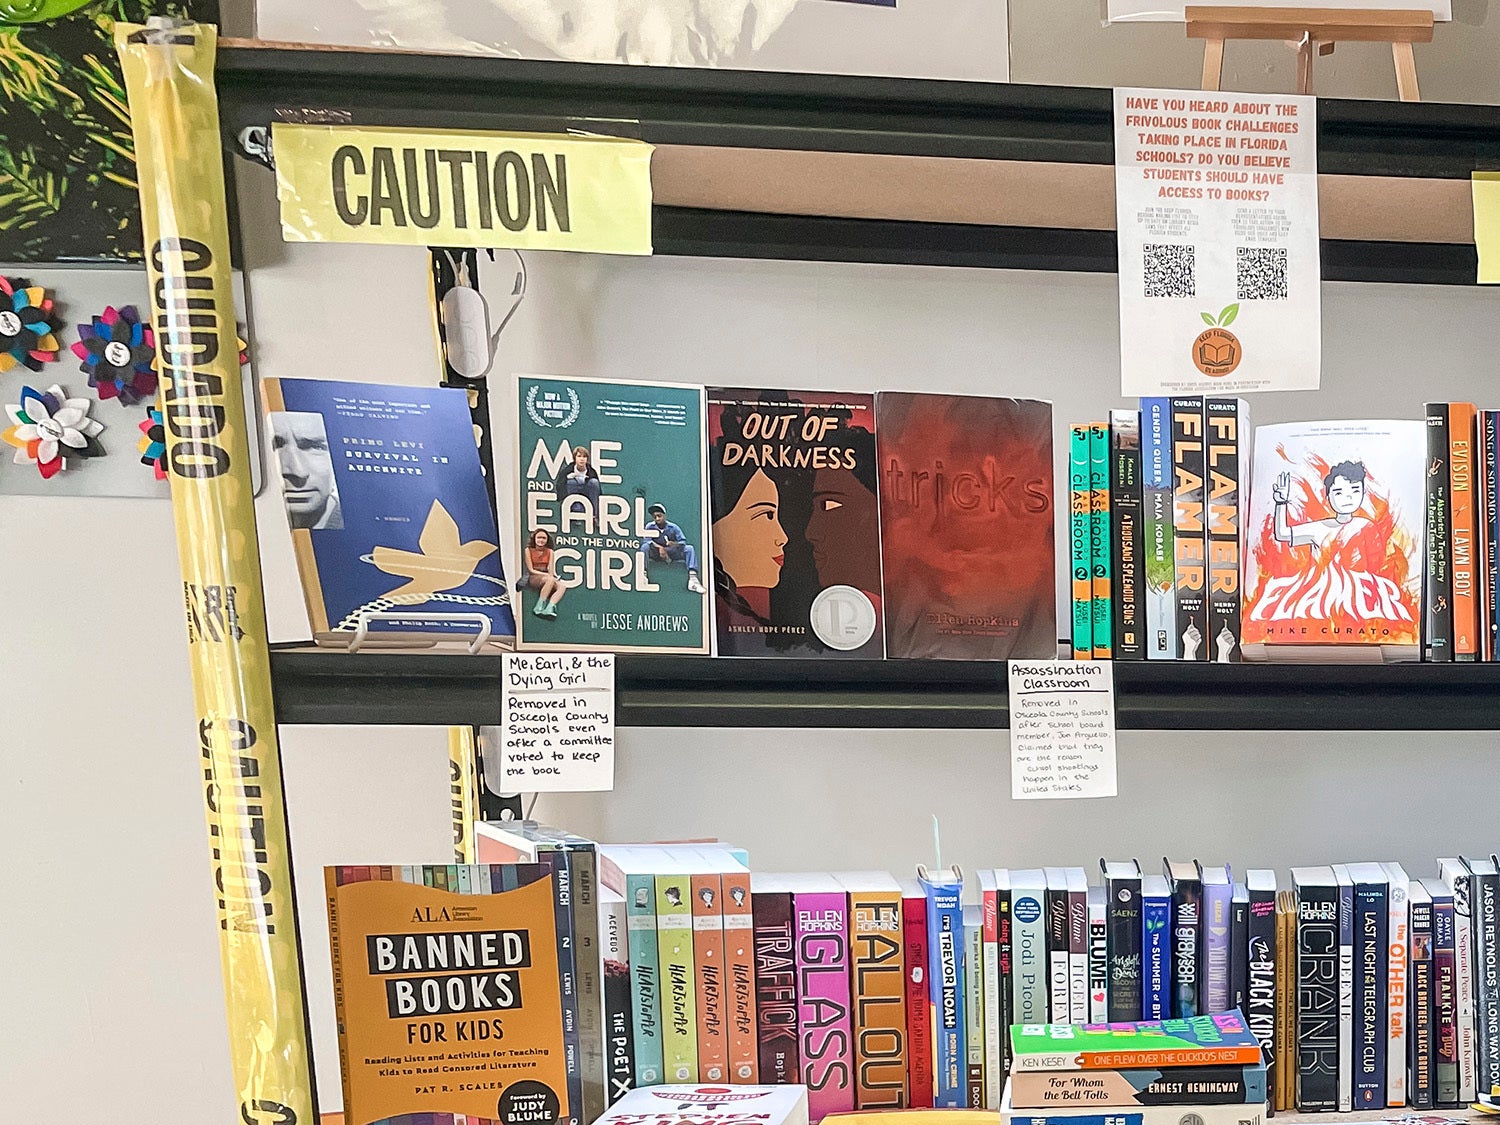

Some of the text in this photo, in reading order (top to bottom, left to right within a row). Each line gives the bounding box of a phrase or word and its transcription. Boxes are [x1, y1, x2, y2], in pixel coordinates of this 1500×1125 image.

[1126, 97, 1298, 116] HAVE YOU HEARD ABOUT THE
[1126, 116, 1298, 133] FRIVOLOUS BOOK CHALLENGES
[1138, 133, 1287, 150] TAKING PLACE IN FLORIDA
[1136, 151, 1290, 168] SCHOOLS? DO YOU BELIEVE
[1143, 169, 1284, 184] STUDENTS SHOULD HAVE
[331, 144, 571, 233] CAUTION
[1158, 187, 1269, 201] ACCESS TO BOOKS?
[152, 238, 231, 480] CUIDADO
[742, 413, 839, 441] OUT OF
[723, 443, 857, 470] DARKNESS
[1174, 411, 1204, 593] FLAMER
[528, 493, 659, 537] EARL
[1452, 440, 1470, 597] EVISON LAWN BOY
[556, 536, 640, 549] AND THE DYING
[553, 549, 660, 593] GIRL
[1249, 569, 1413, 622] FLAMER
[600, 614, 689, 632] JESSE ANDREWS
[1267, 627, 1390, 636] MIKE CURATO
[572, 657, 582, 669] &
[587, 657, 611, 667] the
[1012, 664, 1101, 676] Assassination
[509, 673, 586, 690] Dying Girl
[1024, 680, 1089, 689] Classroom
[376, 932, 524, 972] BANNED
[398, 973, 516, 1015] BOOKS
[1300, 923, 1338, 1074] CRANK
[801, 935, 849, 1091] GLASS
[408, 1019, 504, 1044] FOR KIDS
[1148, 1081, 1239, 1093] ERNEST HEMINGWAY
[512, 1101, 545, 1111] JUDY
[508, 1110, 551, 1122] BLUME
